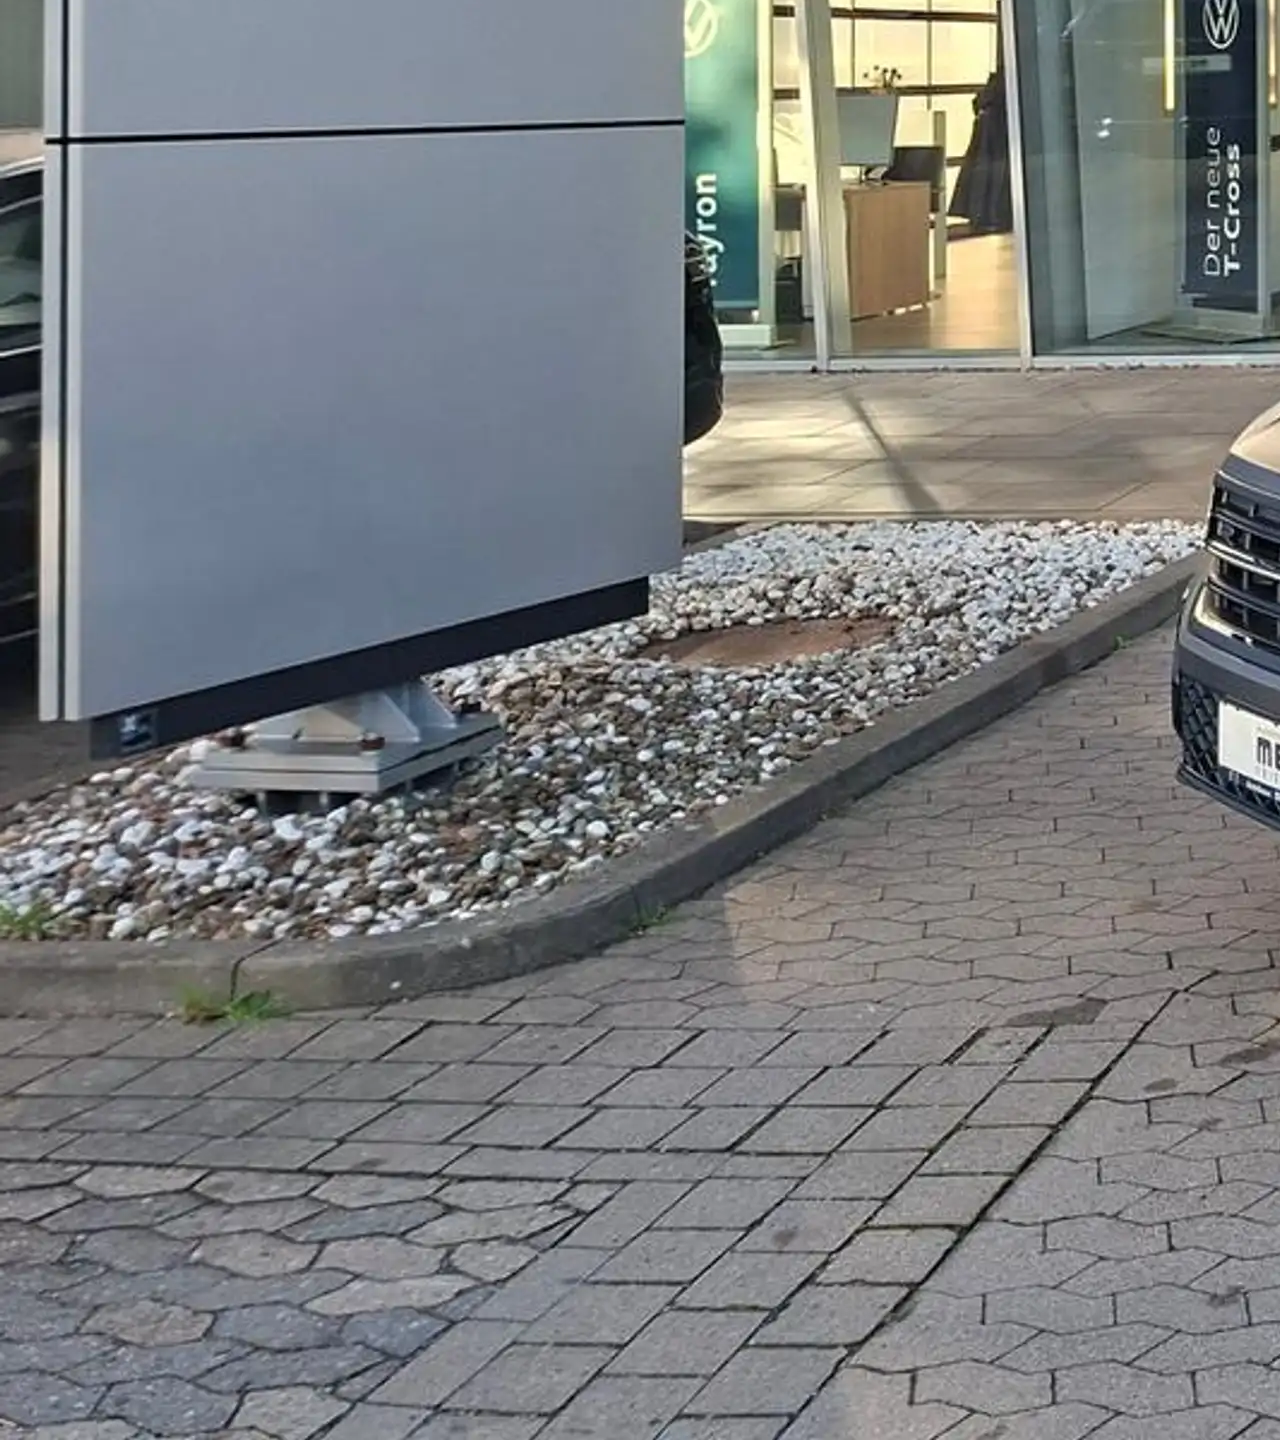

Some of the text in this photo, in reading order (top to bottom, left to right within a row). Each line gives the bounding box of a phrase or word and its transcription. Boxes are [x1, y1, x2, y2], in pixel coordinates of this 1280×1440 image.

[1204, 127, 1221, 277] Der neue
[1223, 143, 1242, 278] T-Cross
